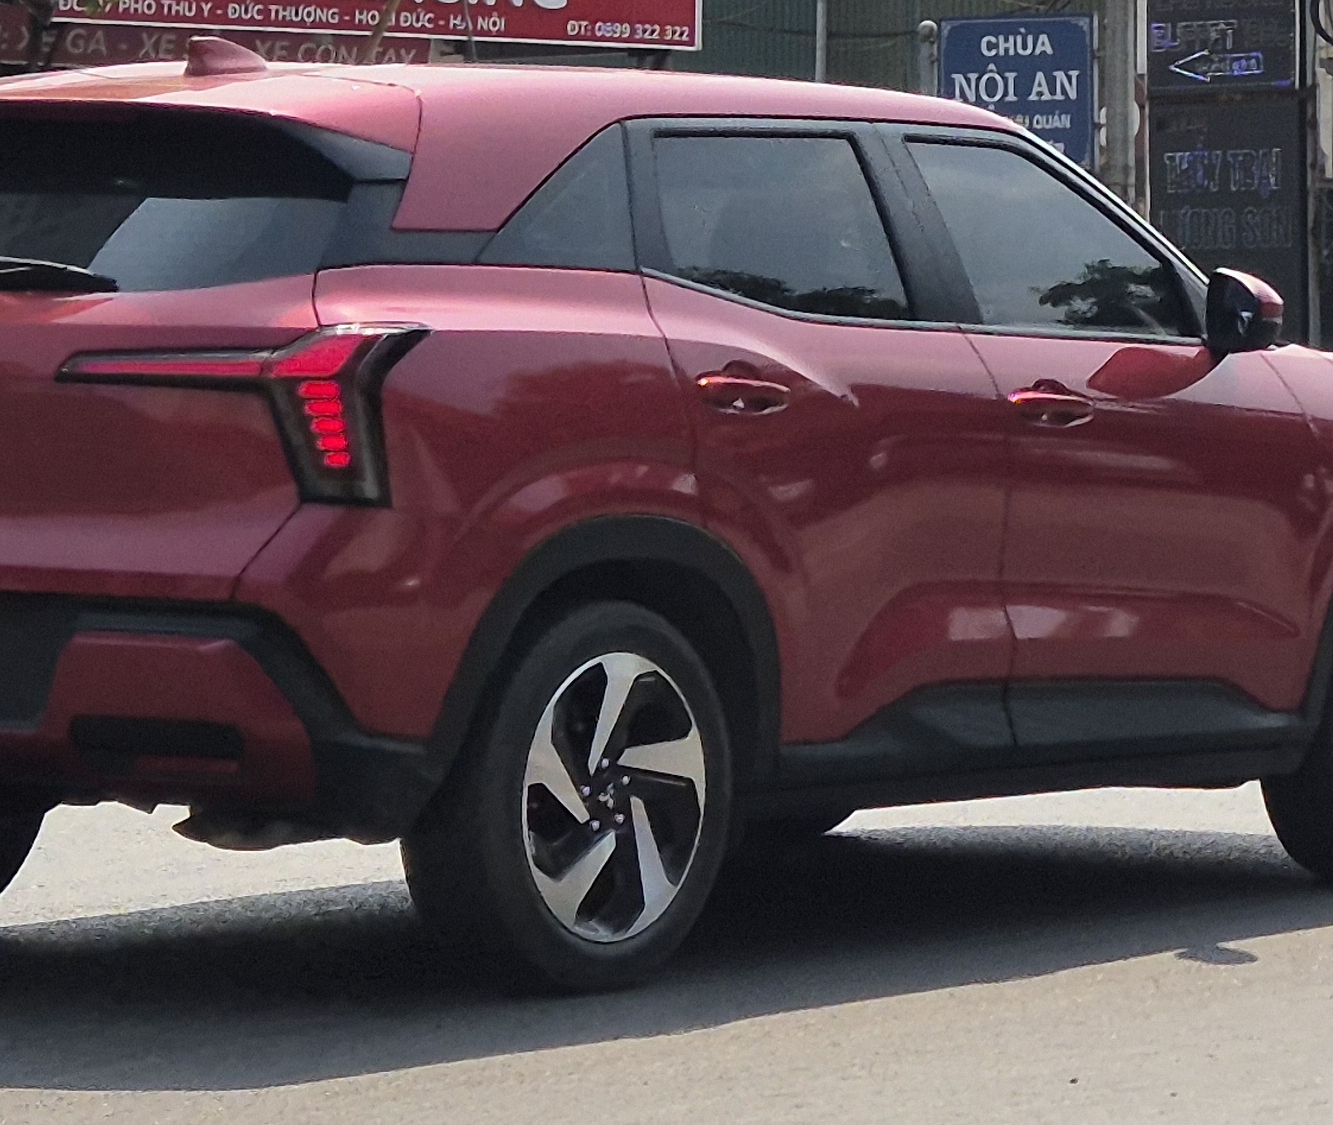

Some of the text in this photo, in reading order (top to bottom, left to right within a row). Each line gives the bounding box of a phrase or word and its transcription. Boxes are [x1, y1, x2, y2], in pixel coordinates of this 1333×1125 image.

[200, 1, 213, 18] Y
[227, 0, 264, 21] ĐỨC
[269, 2, 340, 27] THƯỢNG
[477, 11, 505, 35] NỘI
[634, 24, 661, 41] 322
[664, 25, 690, 43] 322
[980, 27, 1054, 57] CHÙA
[951, 62, 1080, 111] NỘI AN
